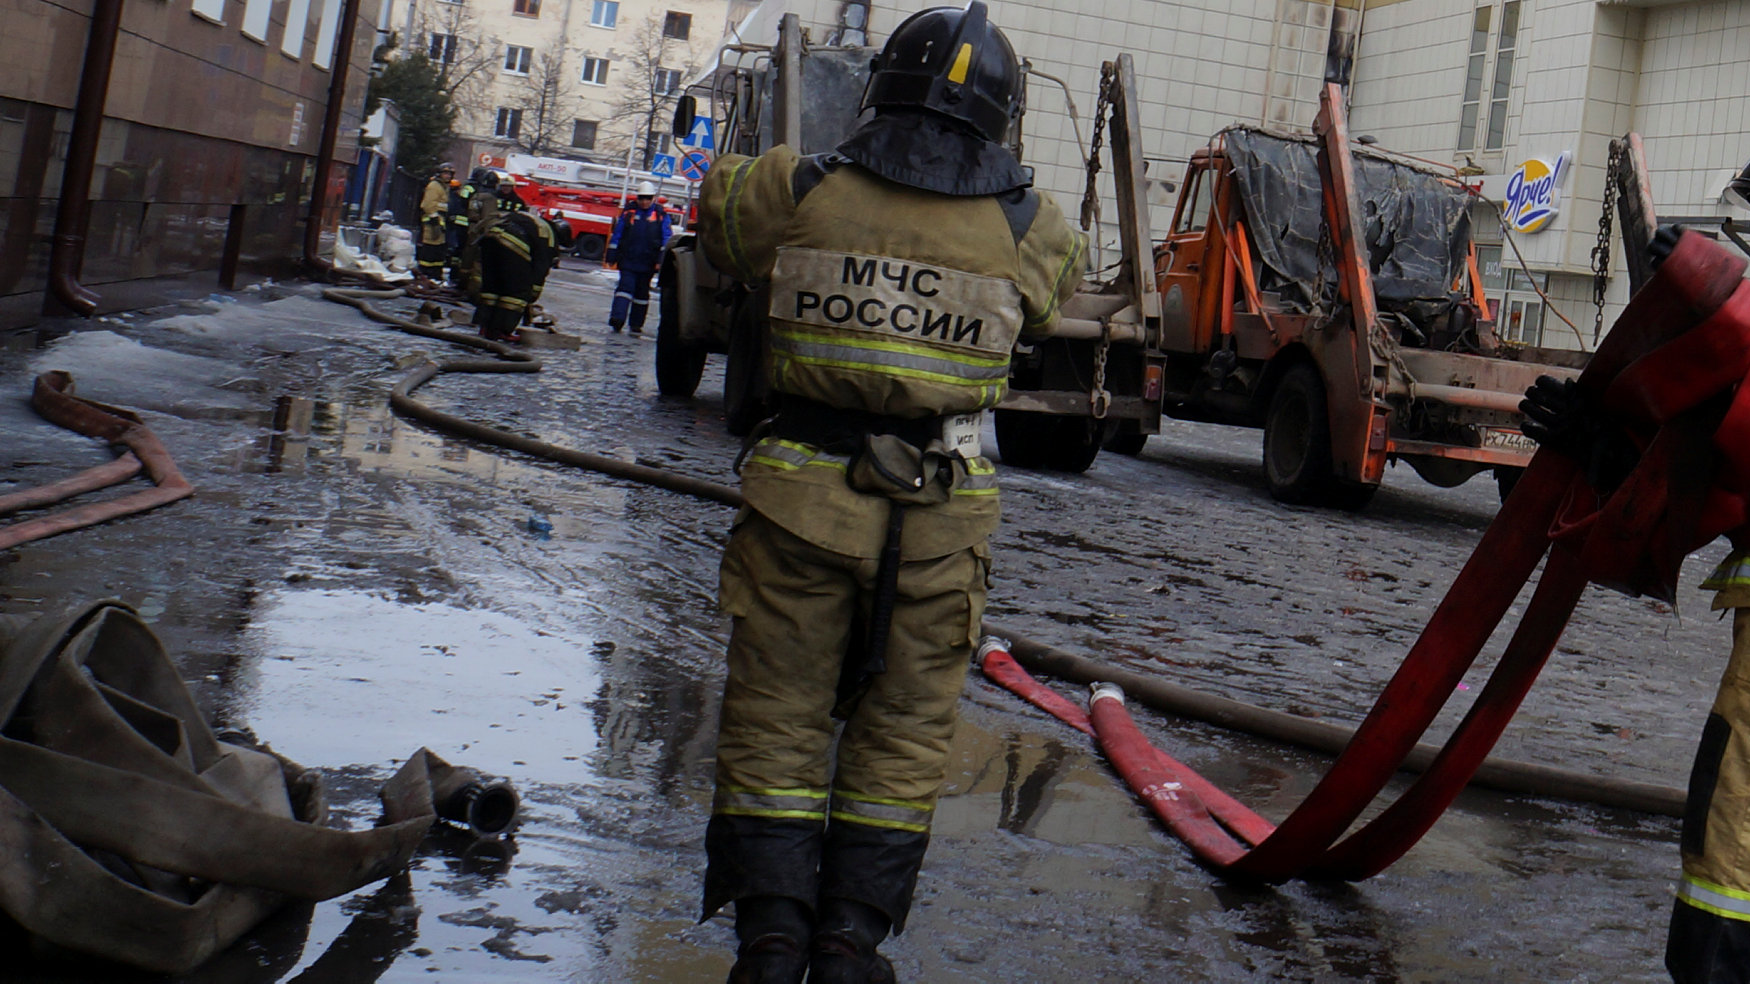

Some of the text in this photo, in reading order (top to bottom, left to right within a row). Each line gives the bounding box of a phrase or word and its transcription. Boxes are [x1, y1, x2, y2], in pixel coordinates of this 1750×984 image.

[1503, 155, 1563, 223] Ярче!
[841, 256, 942, 297] МЧС
[795, 290, 984, 346] РОССИИ
